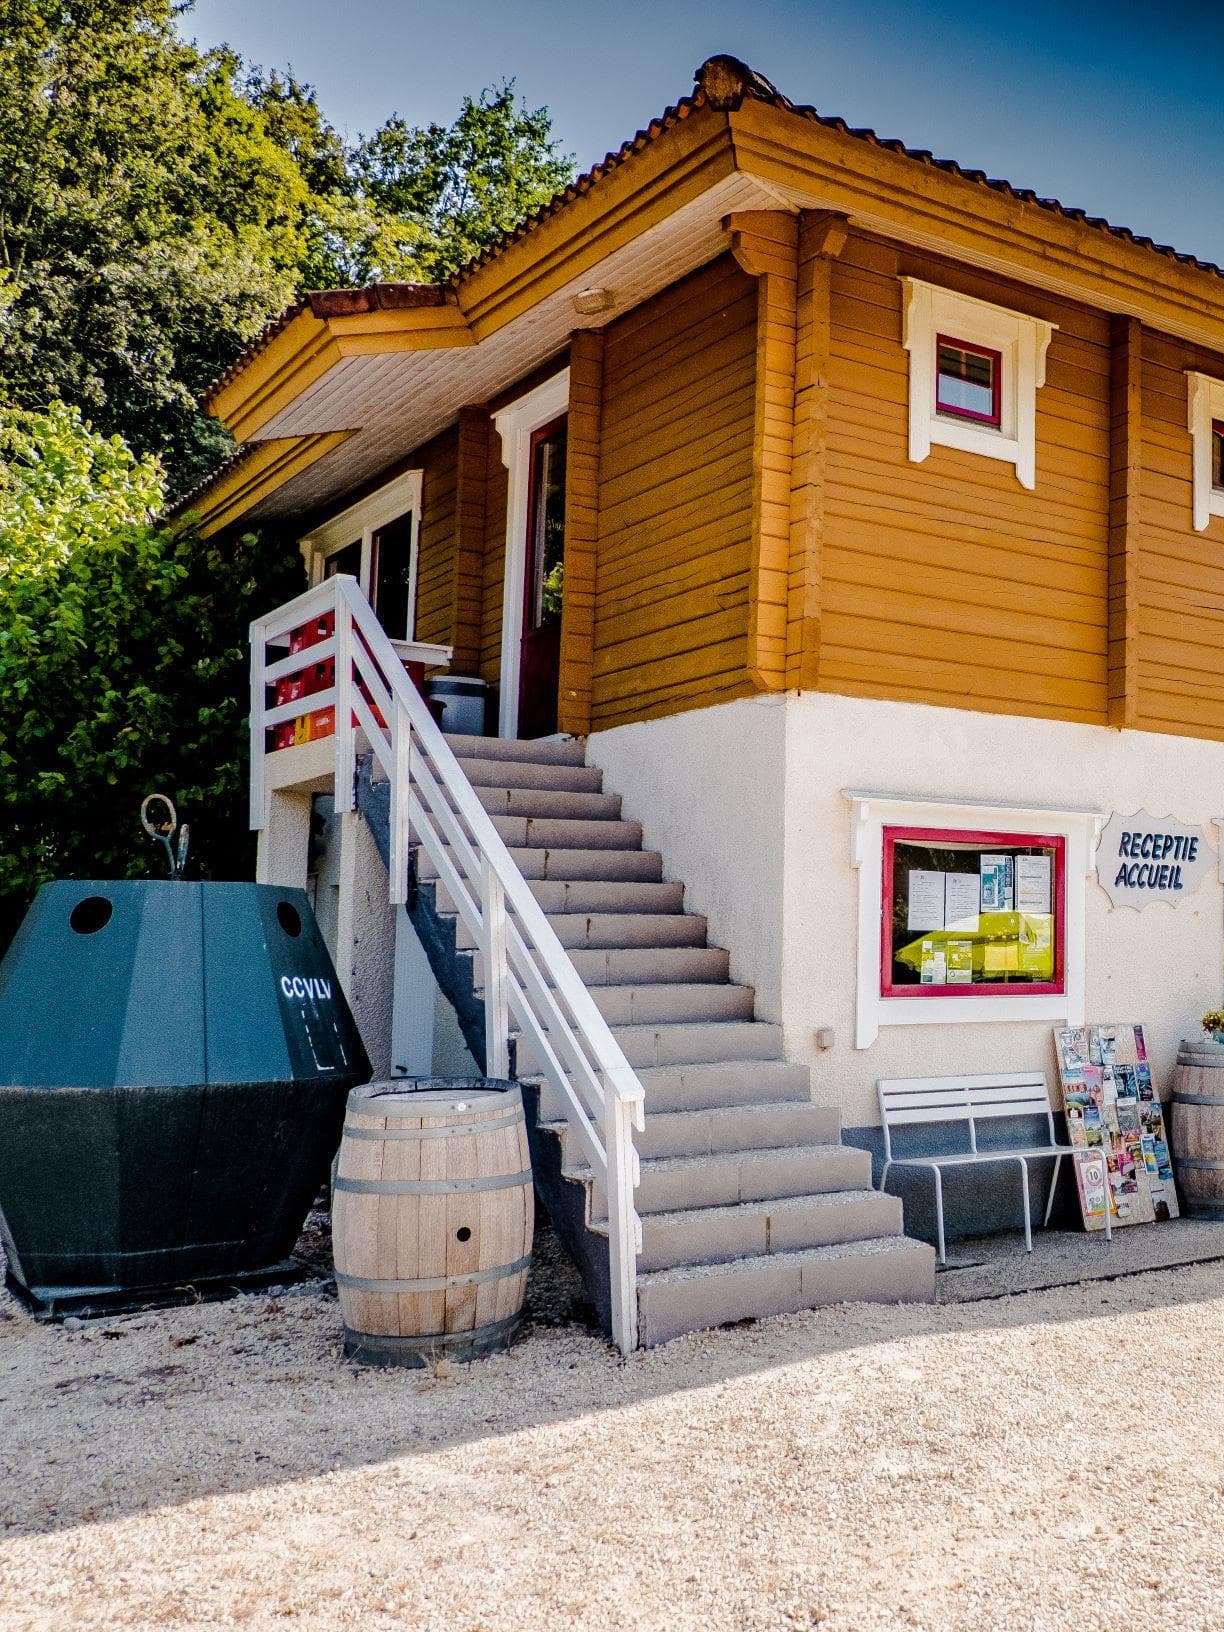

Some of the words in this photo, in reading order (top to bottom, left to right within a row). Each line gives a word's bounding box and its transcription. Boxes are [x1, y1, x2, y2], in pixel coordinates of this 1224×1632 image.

[1118, 831, 1199, 862] RECEPTIE
[1114, 862, 1184, 890] ACCUEIL
[281, 976, 332, 999] CCVLV
[1089, 1171, 1099, 1180] 10
